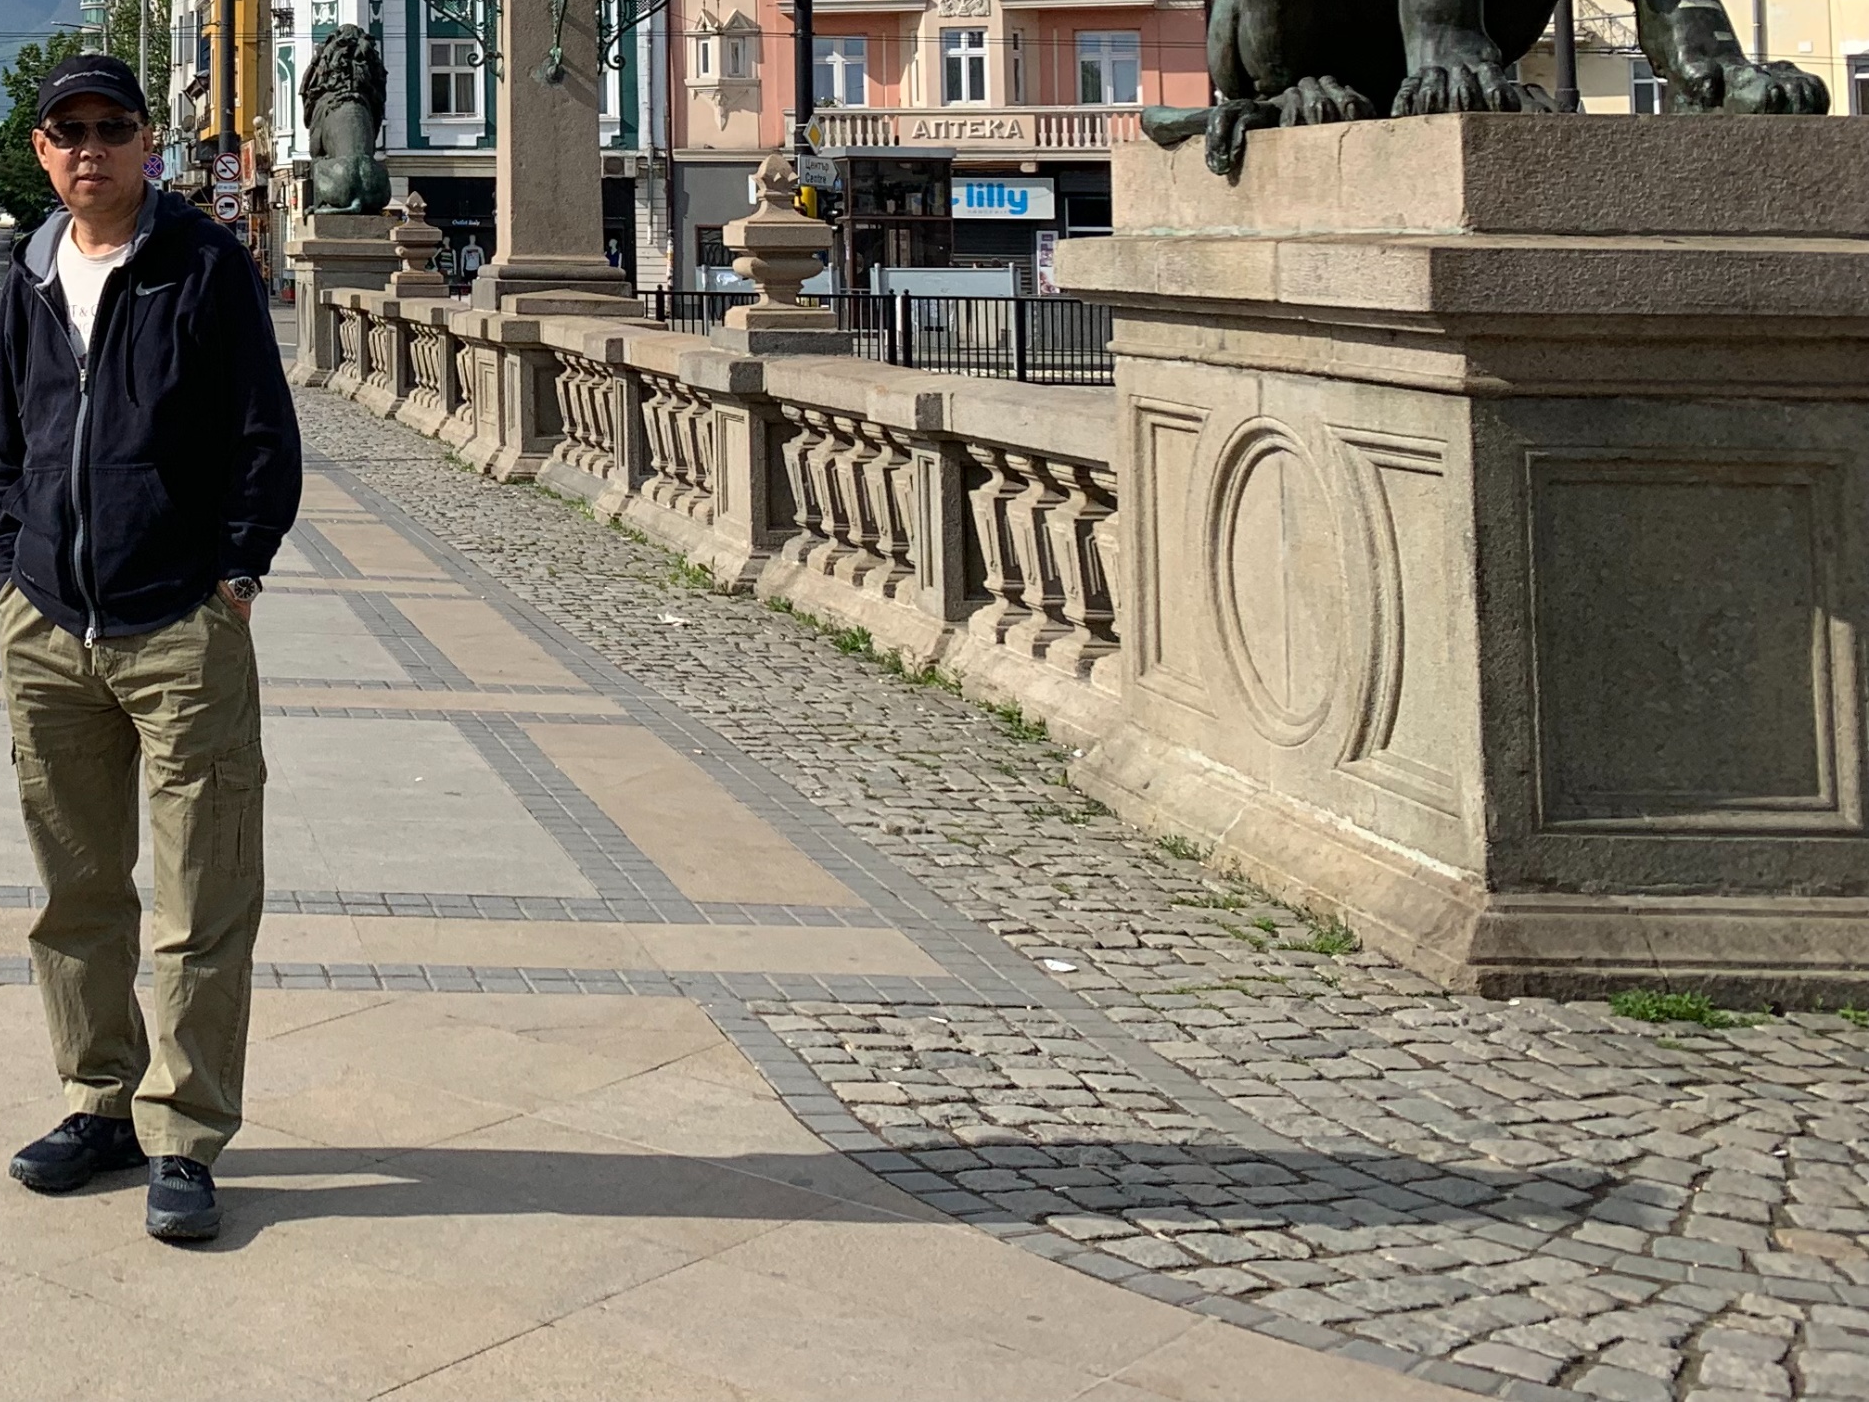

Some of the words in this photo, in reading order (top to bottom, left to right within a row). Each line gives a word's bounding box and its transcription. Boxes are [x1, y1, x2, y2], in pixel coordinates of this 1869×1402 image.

[912, 119, 1024, 139] АПТЕКА
[805, 159, 829, 172] Център
[805, 172, 826, 183] Centre
[966, 183, 1028, 215] lilly
